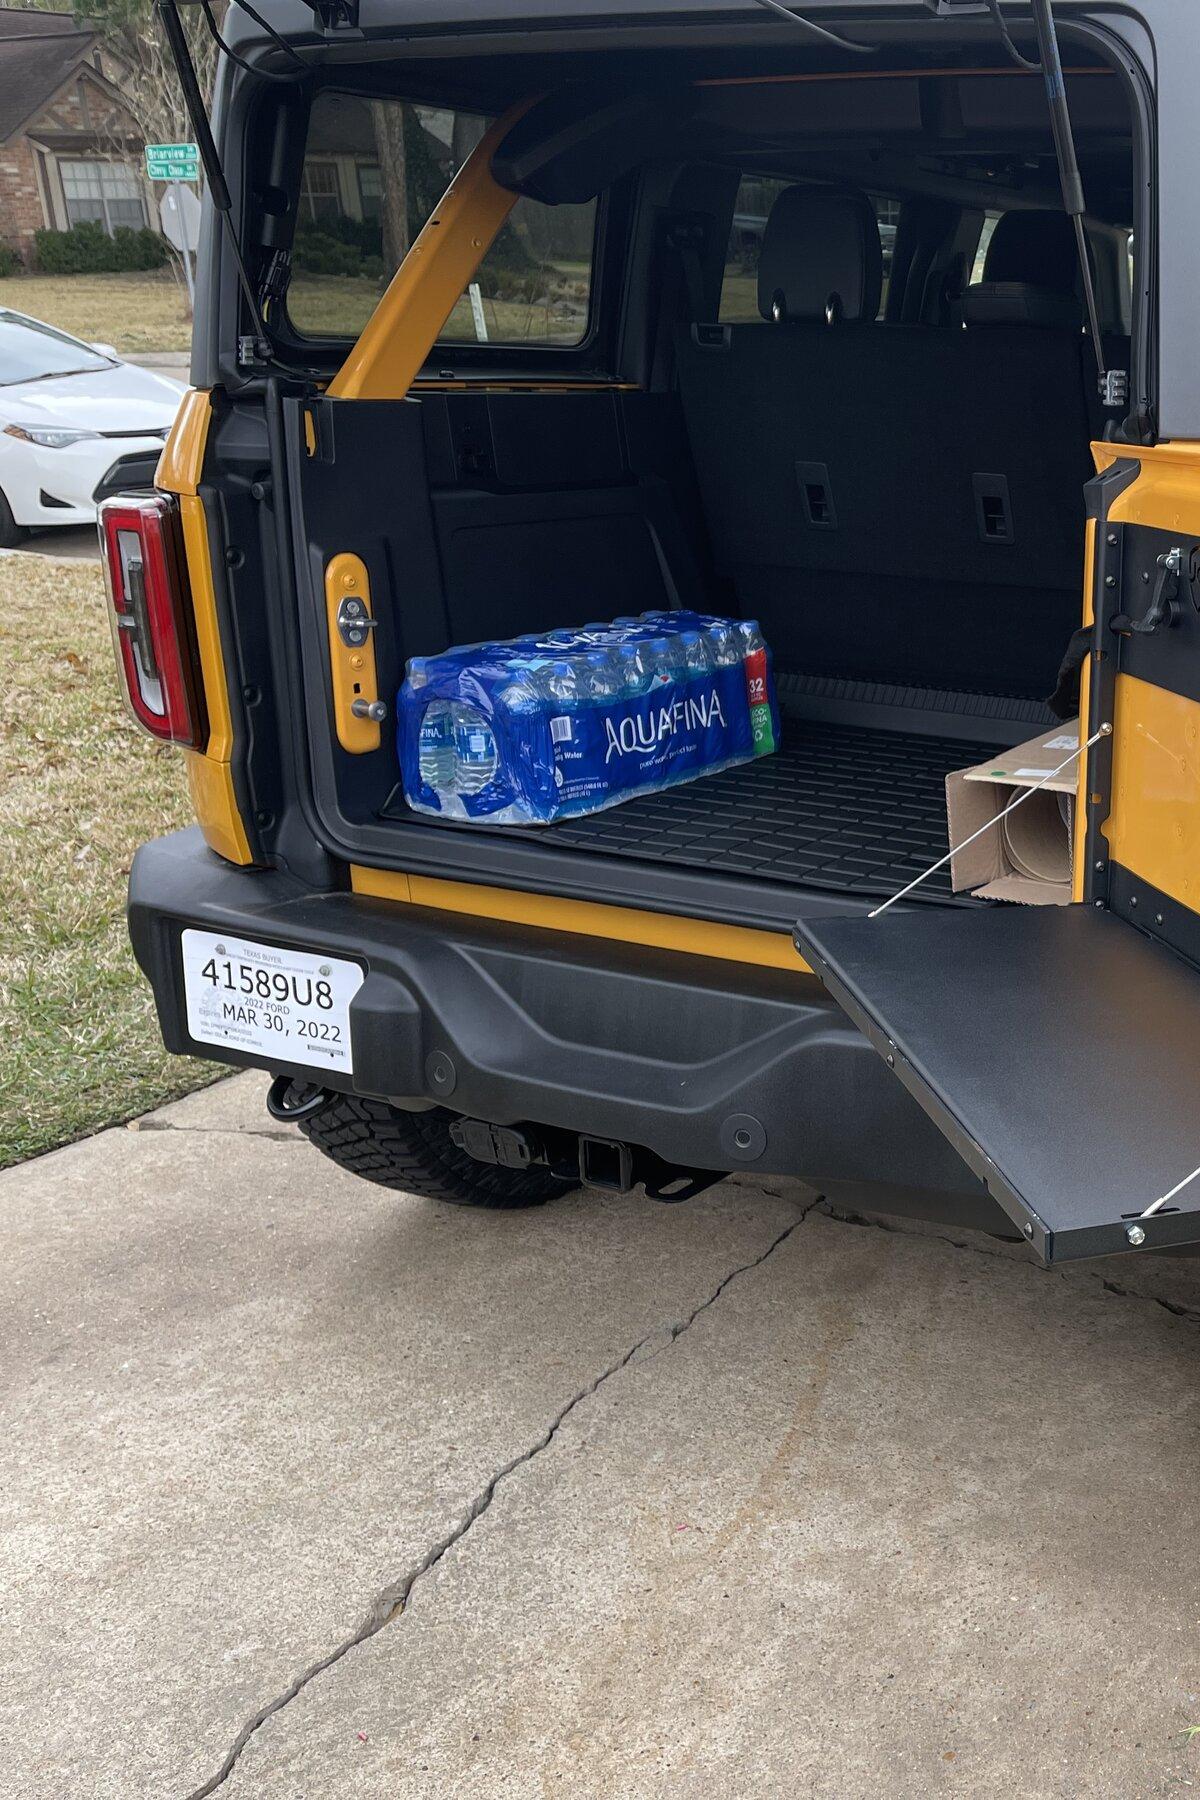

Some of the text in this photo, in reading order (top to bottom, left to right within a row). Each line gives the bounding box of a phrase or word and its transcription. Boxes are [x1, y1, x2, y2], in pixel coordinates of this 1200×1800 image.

[148, 147, 184, 160] Briarview
[749, 678, 764, 693] 32
[605, 689, 727, 764] AQUAFINA
[564, 751, 582, 759] Water
[243, 949, 261, 959] TEXAS
[261, 952, 283, 964] BUYER
[202, 958, 334, 1010] 41589U8
[244, 997, 291, 1015] 2022 FORD
[223, 1002, 259, 1027] MAR
[263, 1012, 290, 1037] 30,
[297, 1019, 342, 1043] 2022
